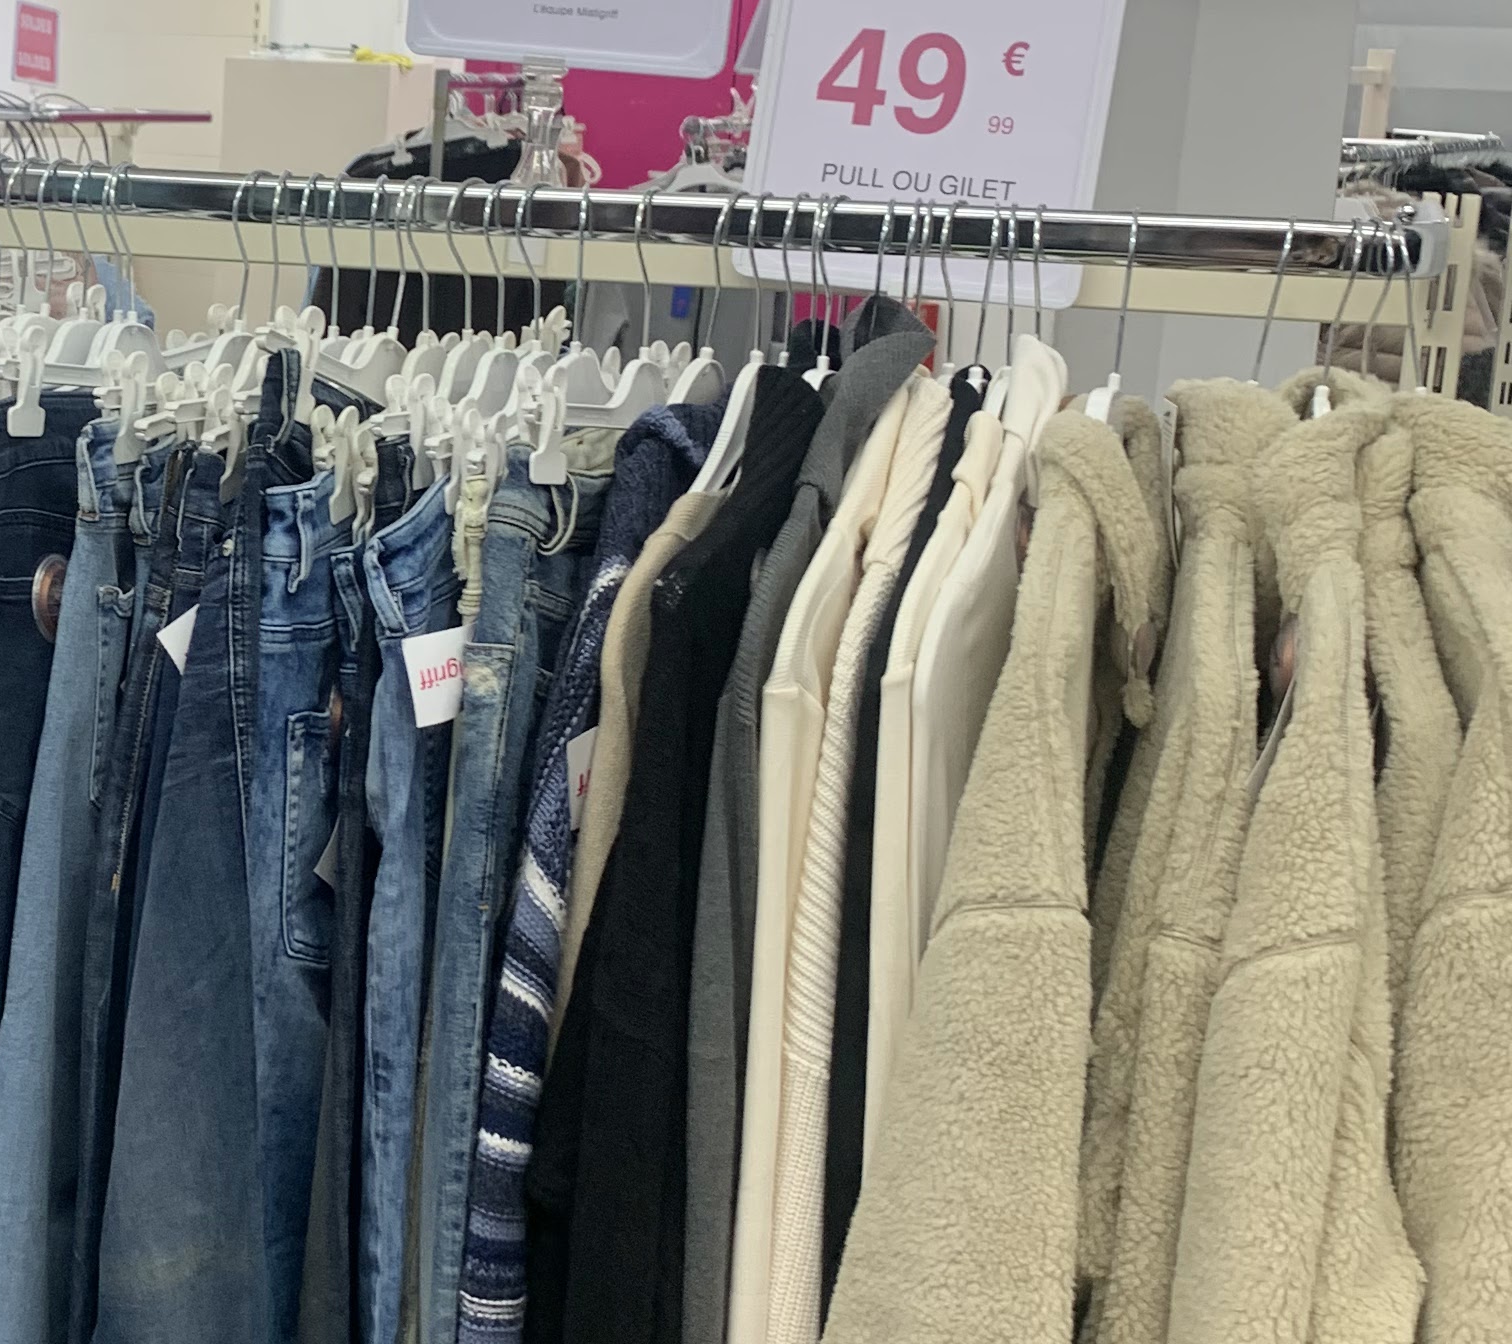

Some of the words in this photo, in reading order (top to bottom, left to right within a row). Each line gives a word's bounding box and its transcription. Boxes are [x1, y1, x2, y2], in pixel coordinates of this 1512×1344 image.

[815, 27, 968, 135] 49
[1002, 41, 1030, 77] €
[987, 115, 1015, 135] 99
[821, 163, 884, 188] PULL
[892, 169, 932, 193] OU
[939, 175, 1017, 201] GILET
